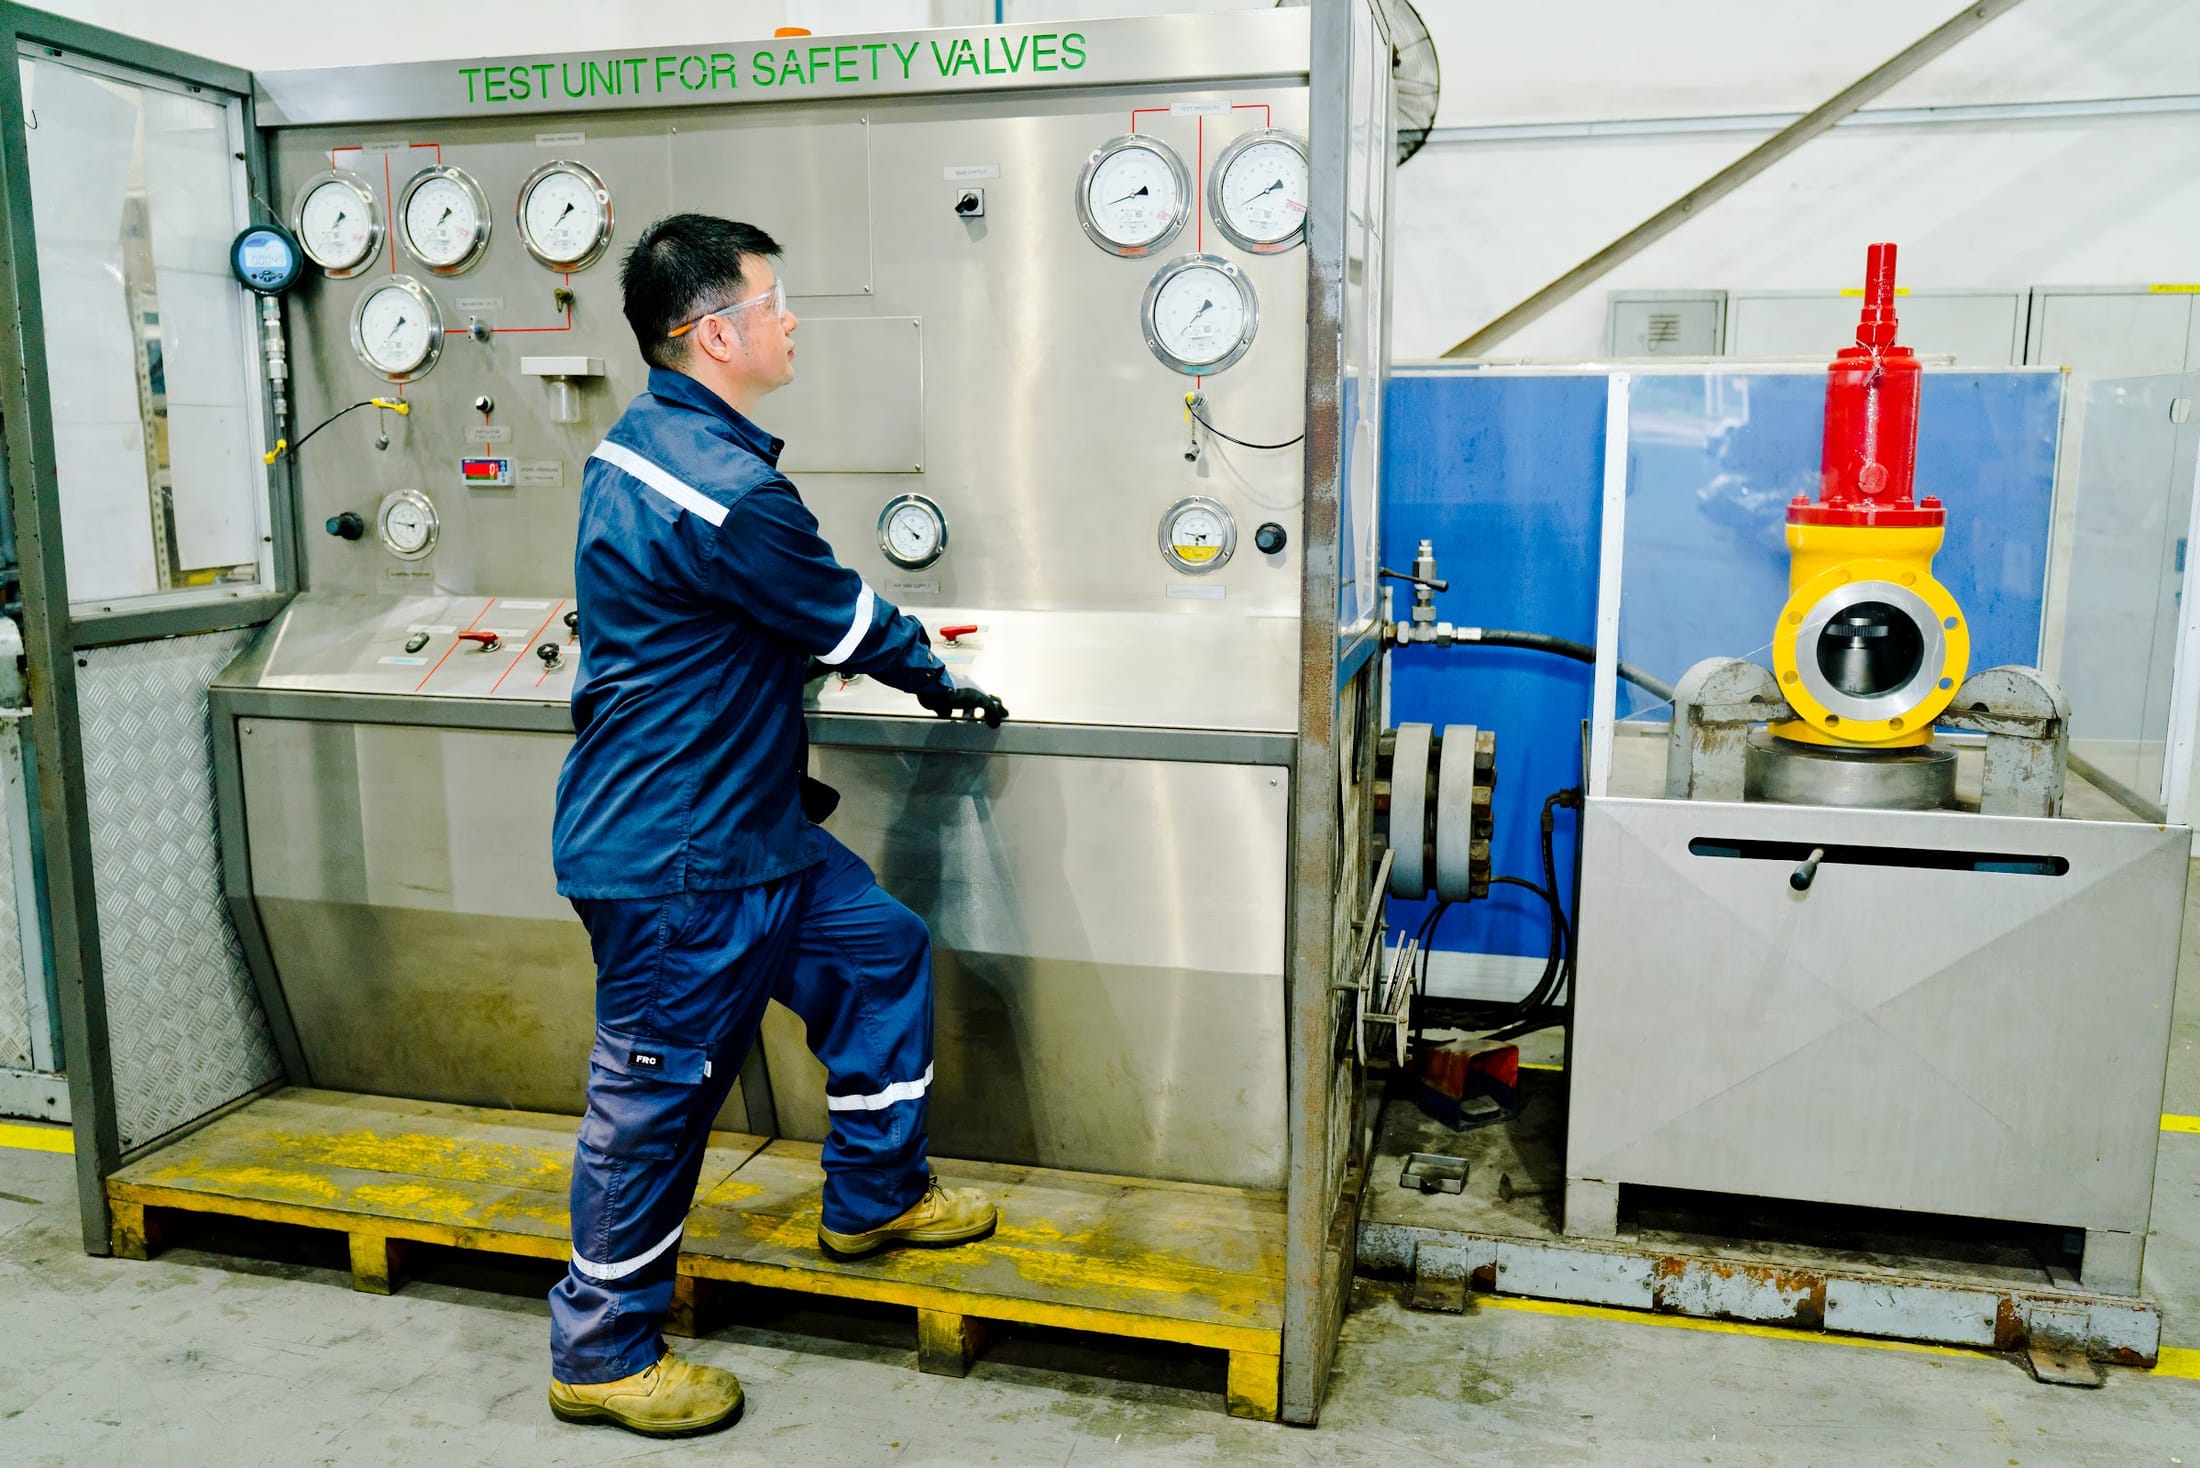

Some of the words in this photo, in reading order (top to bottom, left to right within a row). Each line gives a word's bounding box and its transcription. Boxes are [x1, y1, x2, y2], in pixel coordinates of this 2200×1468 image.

[458, 63, 555, 103] TEST
[562, 58, 648, 98] UNIT
[655, 53, 737, 93] FOR
[752, 41, 920, 87] SAFETY
[930, 33, 1087, 77] VALVES
[636, 1055, 657, 1065] FRC
